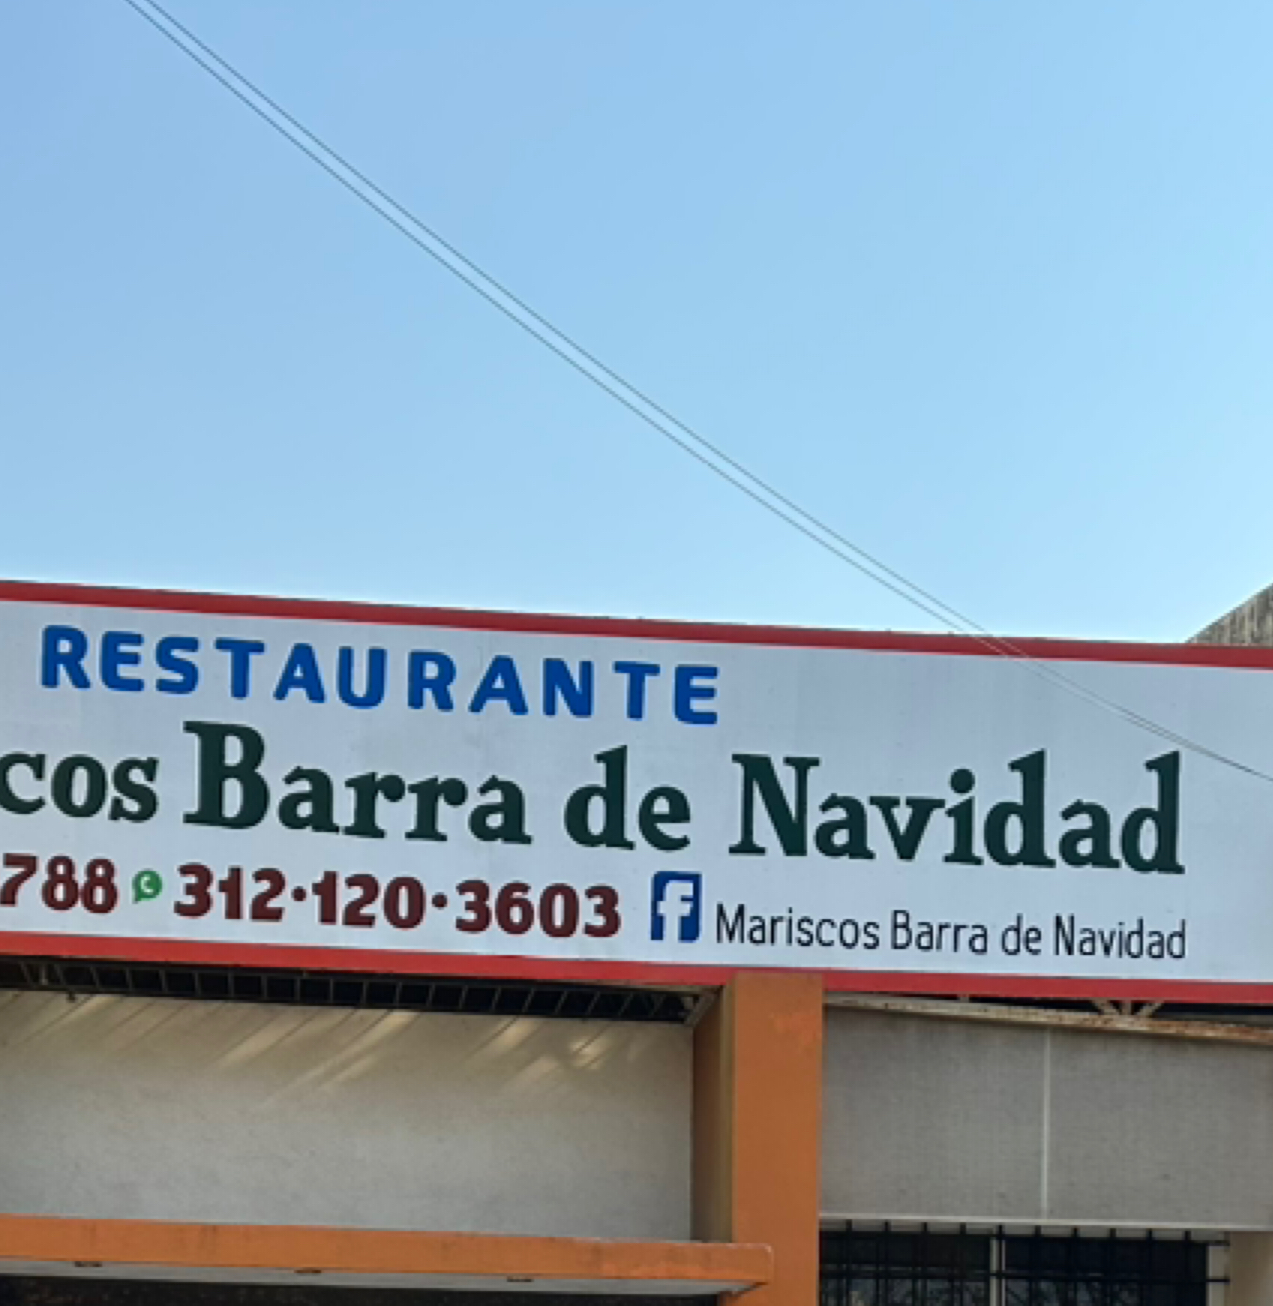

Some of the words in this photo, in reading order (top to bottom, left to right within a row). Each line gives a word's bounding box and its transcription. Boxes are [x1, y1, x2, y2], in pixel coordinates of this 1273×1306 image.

[42, 625, 718, 724] RESTAURANTE
[183, 721, 532, 845] Barra
[564, 745, 690, 851] de
[729, 751, 1186, 874] Navidad
[717, 904, 879, 950] Mariscos
[891, 910, 987, 956] Barra
[1002, 915, 1042, 956] de
[1055, 915, 1186, 959] Navidad
